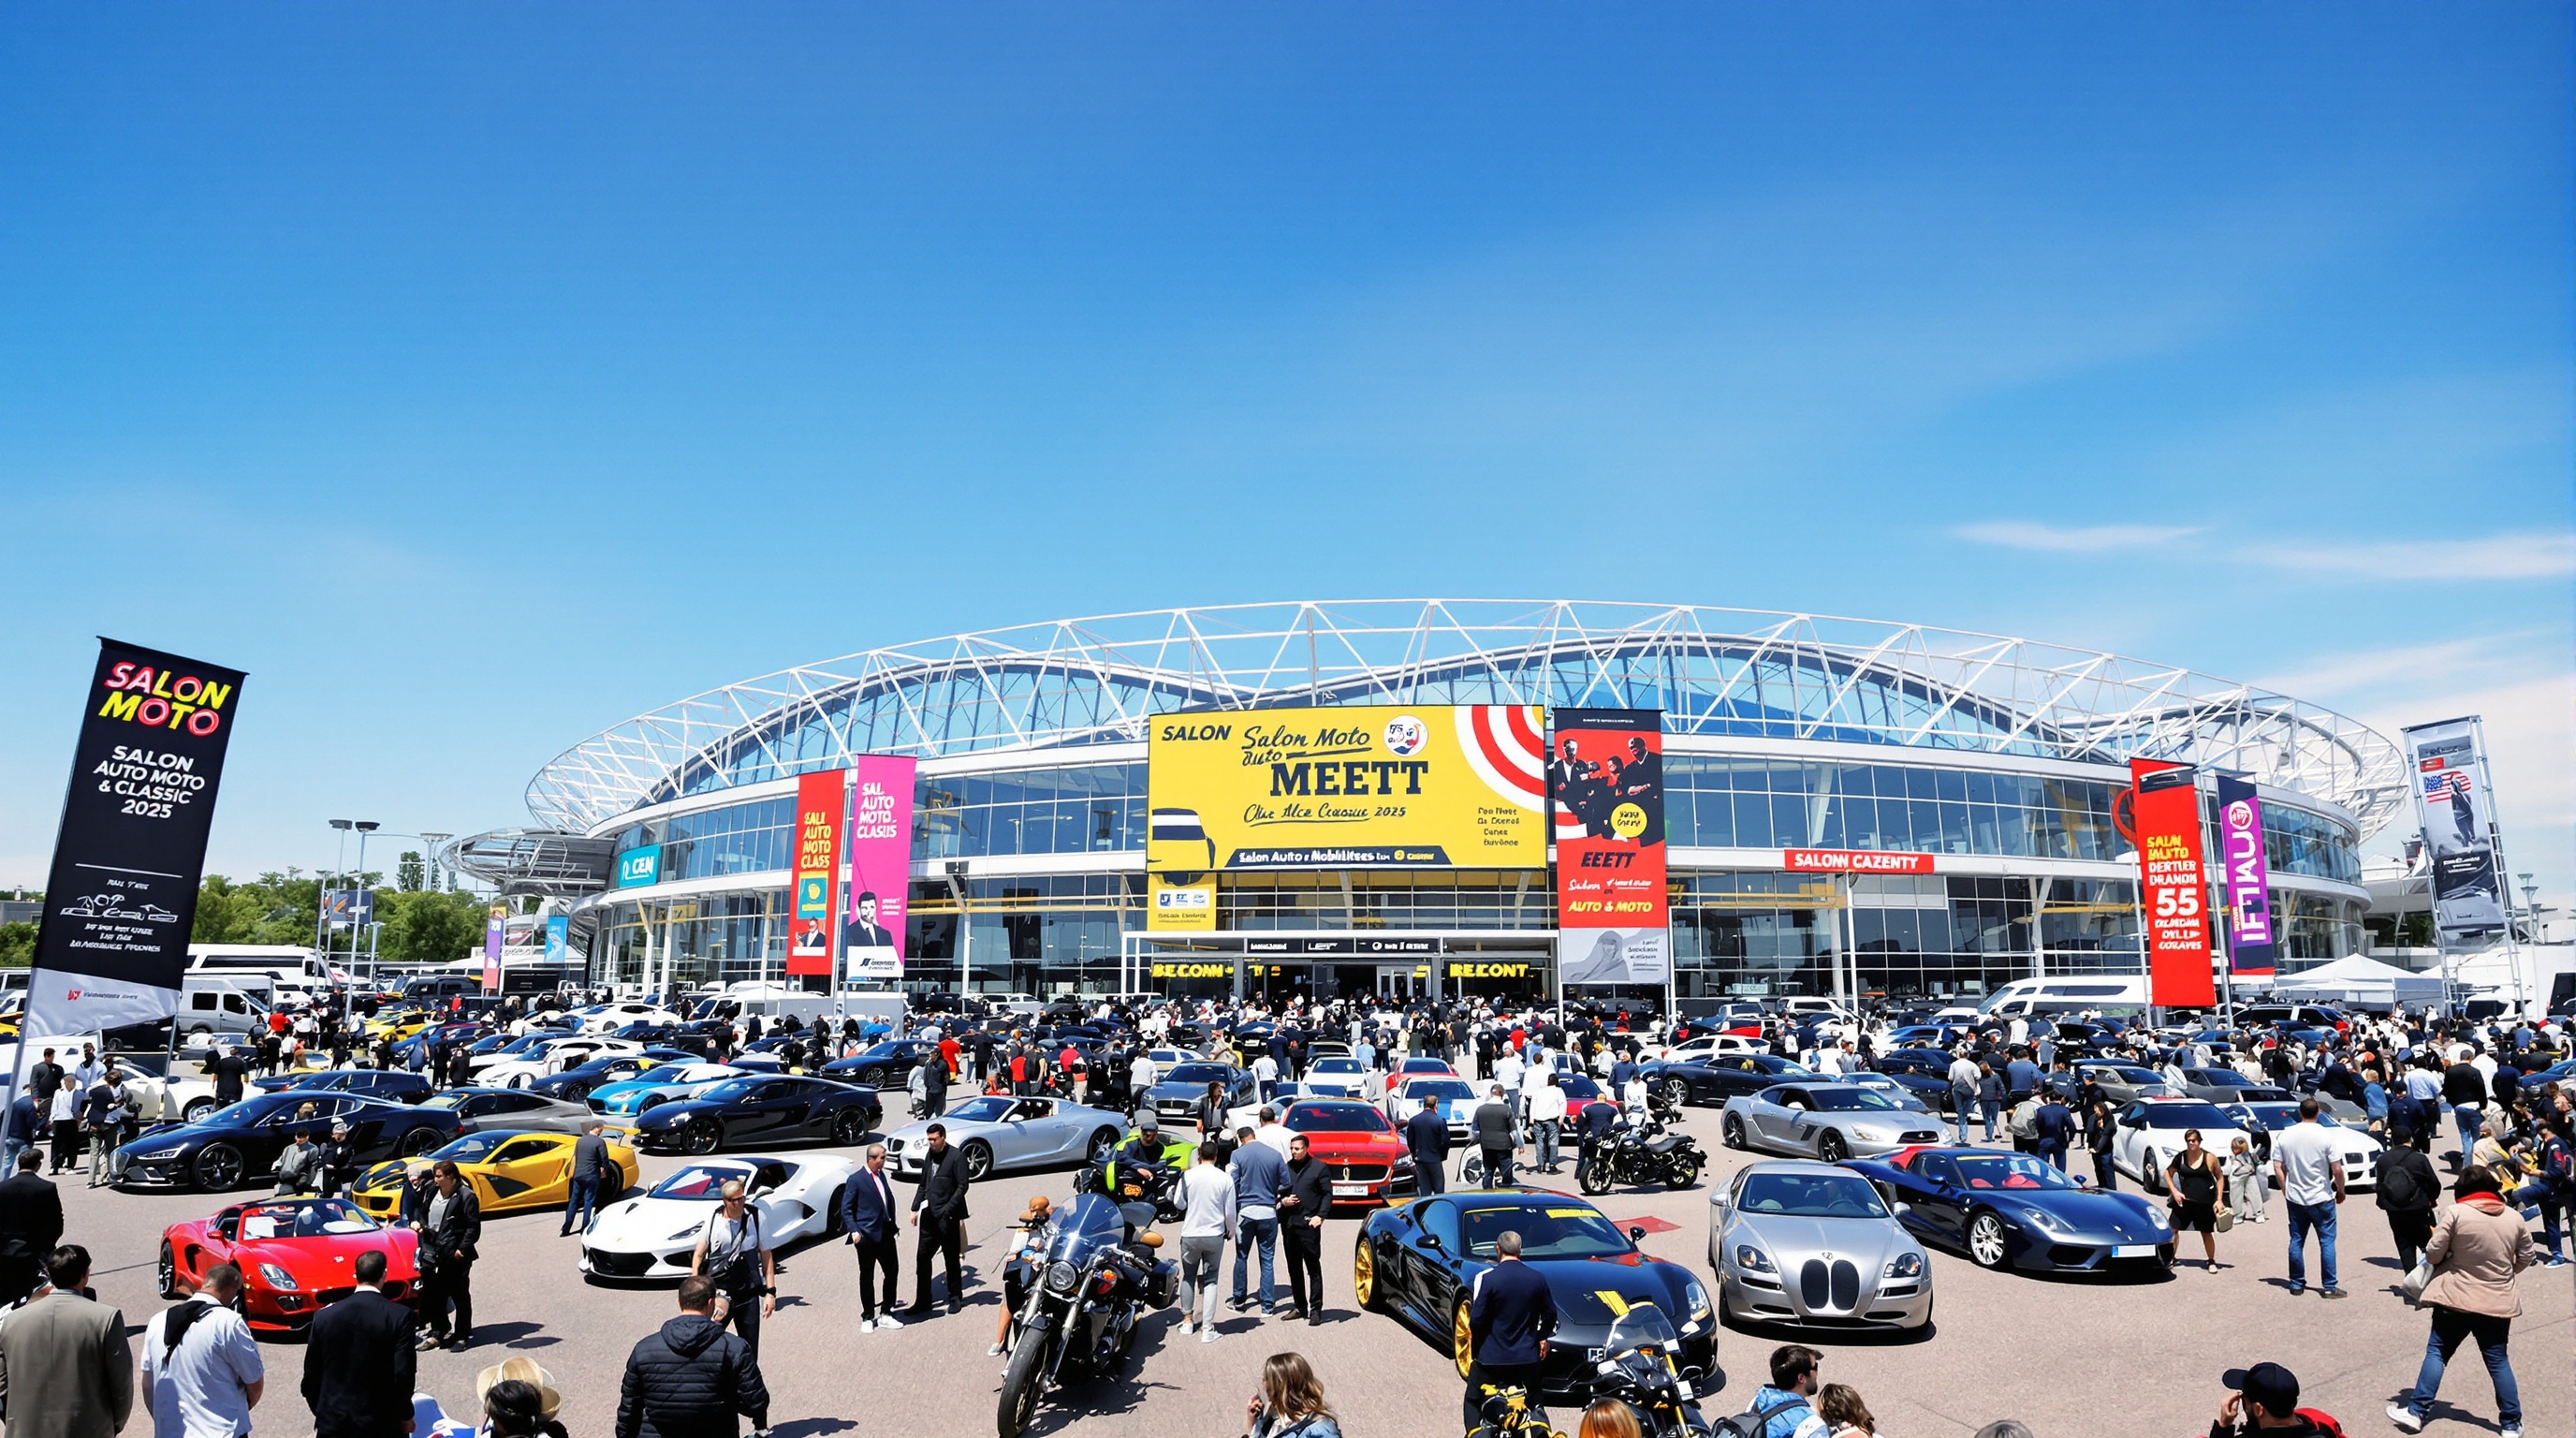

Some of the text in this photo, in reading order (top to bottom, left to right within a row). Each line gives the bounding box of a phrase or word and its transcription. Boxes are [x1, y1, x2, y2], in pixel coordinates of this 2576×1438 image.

[104, 661, 232, 710] SALON
[98, 691, 219, 737] MOTO
[1162, 725, 1232, 741] SALON
[1241, 726, 1370, 750] Salon Moto
[111, 745, 194, 772] SALON
[93, 760, 205, 790] AUTO MOTO
[1270, 761, 1428, 797] MEETT
[98, 780, 193, 804] & CLASSIC
[860, 796, 895, 810] AUTO
[121, 800, 173, 819] 2025
[803, 825, 831, 840] AUTO
[1581, 852, 1636, 868] EEETT
[1567, 901, 1653, 912] AUTO & MOTO
[2156, 888, 2199, 917] 55
